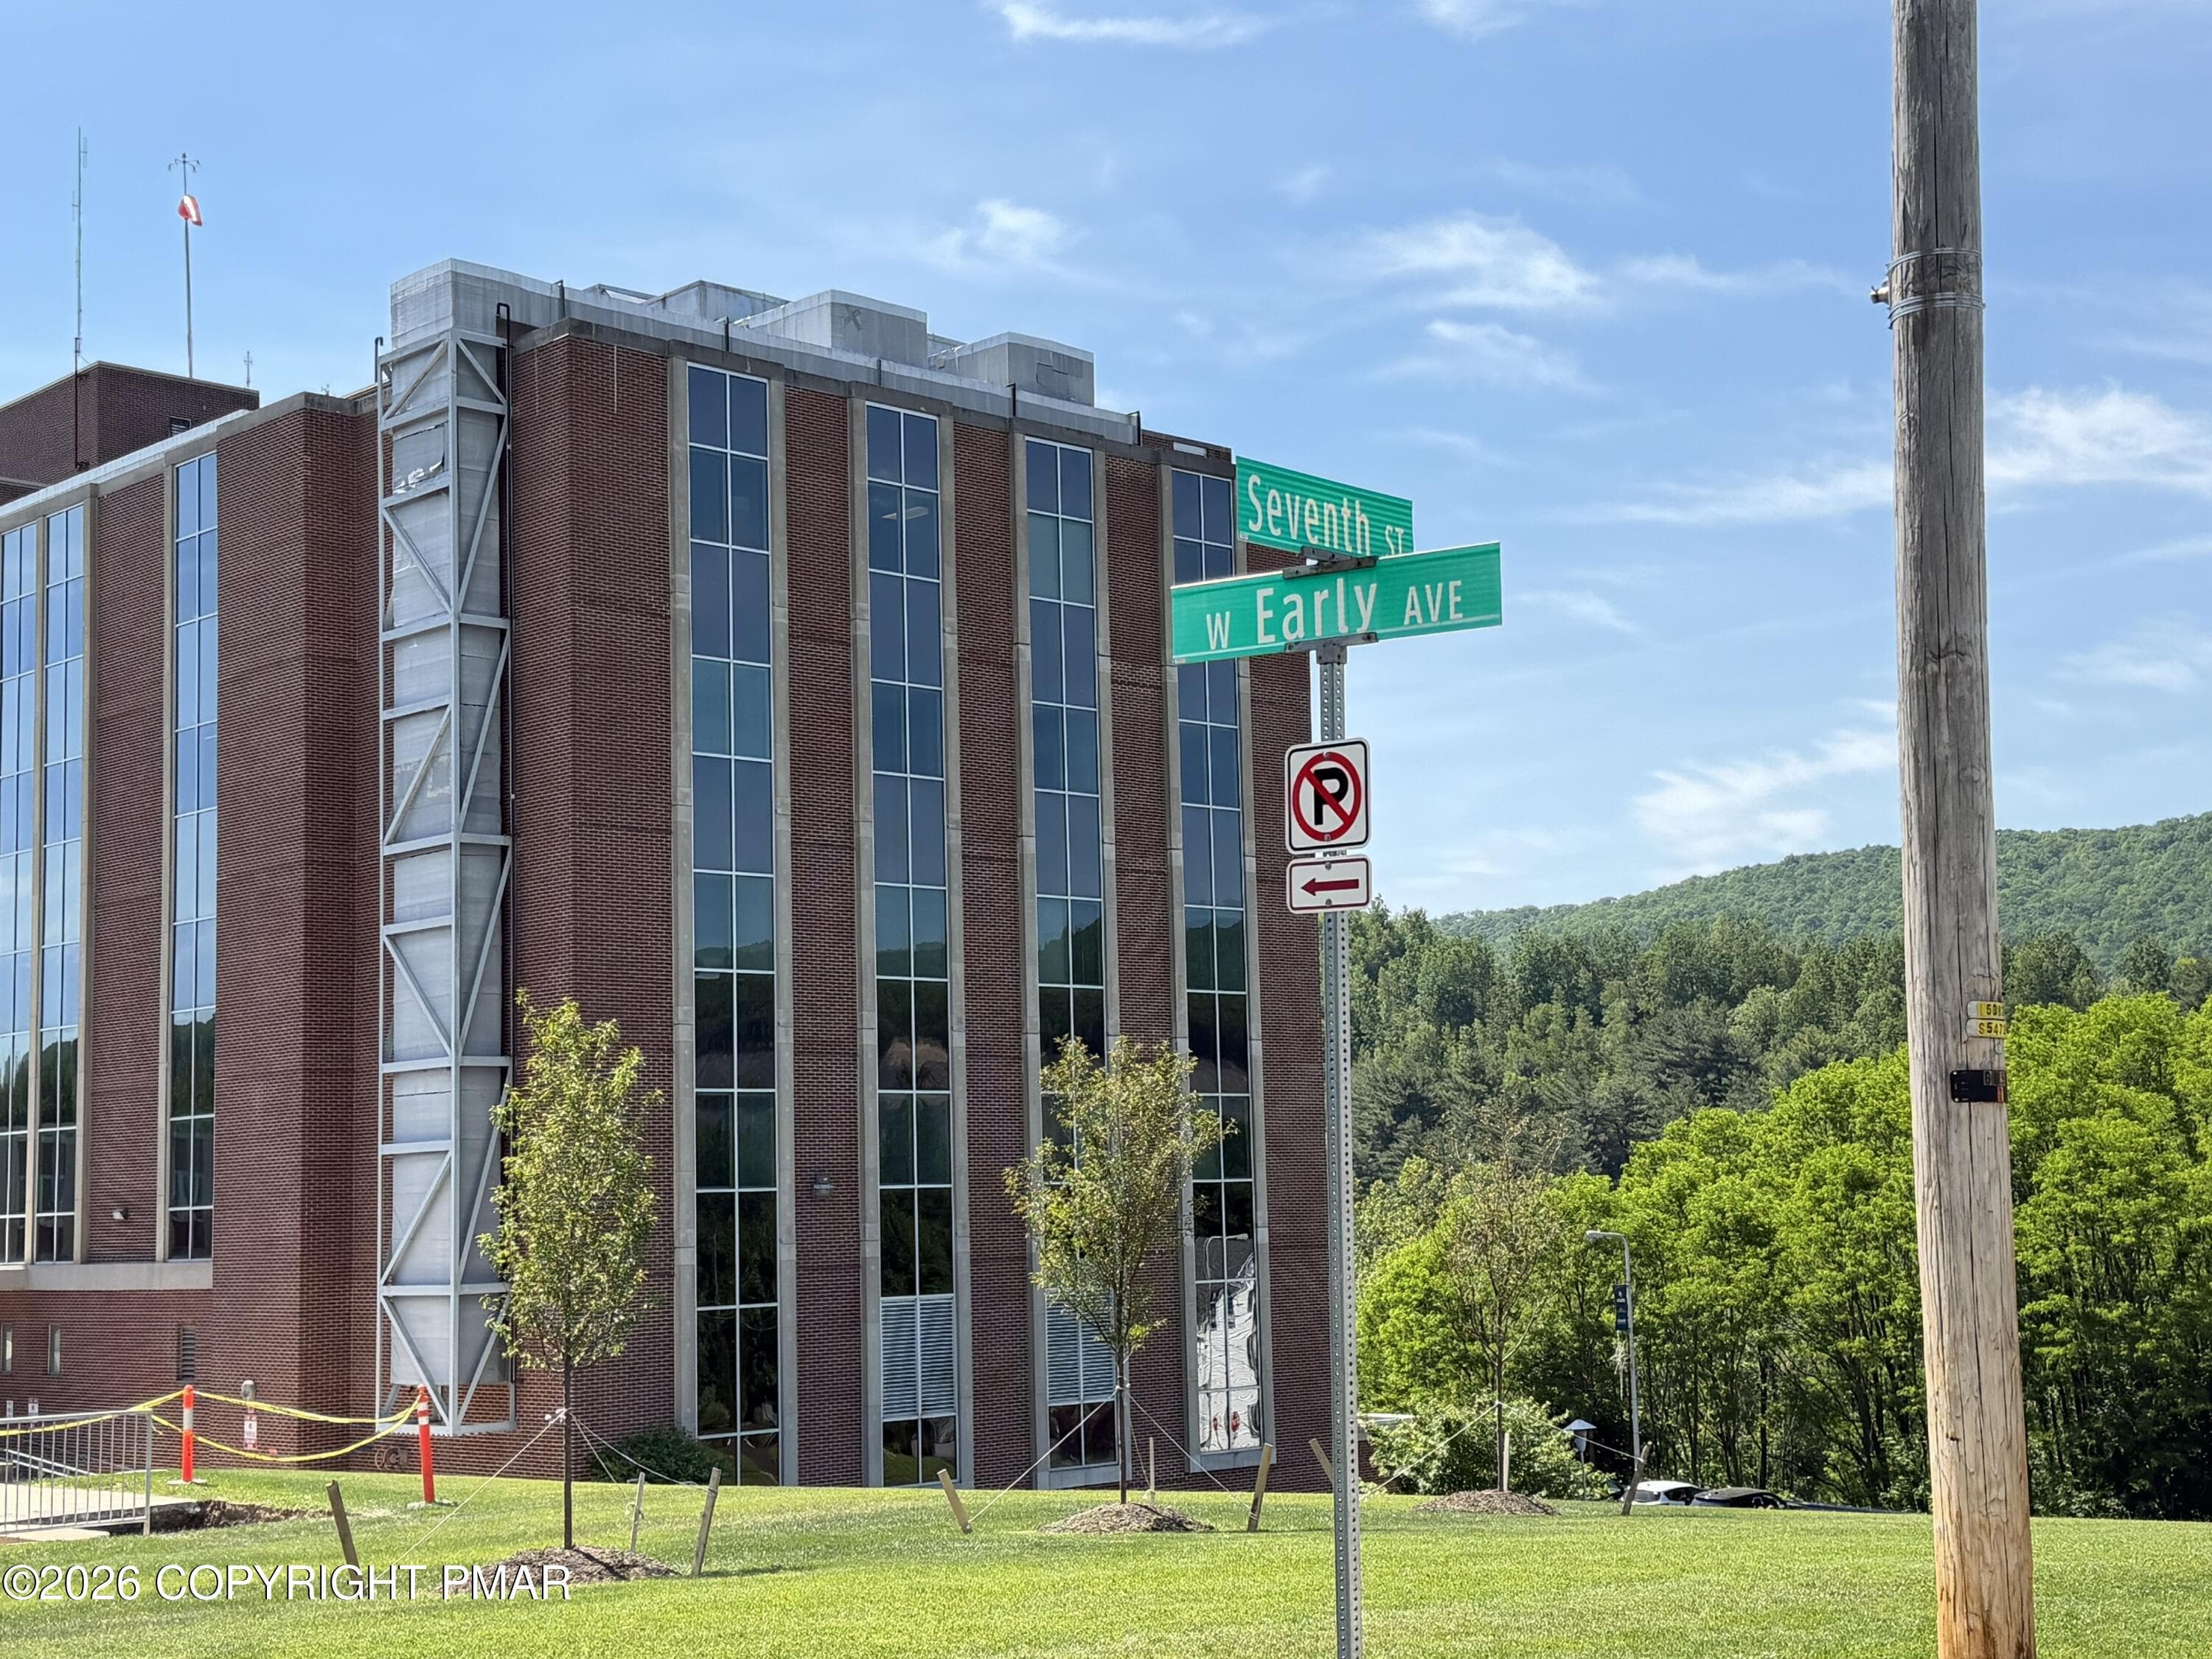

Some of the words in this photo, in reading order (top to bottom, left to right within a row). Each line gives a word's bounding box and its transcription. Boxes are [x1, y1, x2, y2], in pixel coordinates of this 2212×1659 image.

[1248, 474, 1371, 556] Seventh
[1385, 524, 1405, 555] ST
[1206, 611, 1231, 650] W
[1256, 578, 1377, 644] Early
[1404, 580, 1464, 626] AVE
[1314, 767, 1349, 826] P
